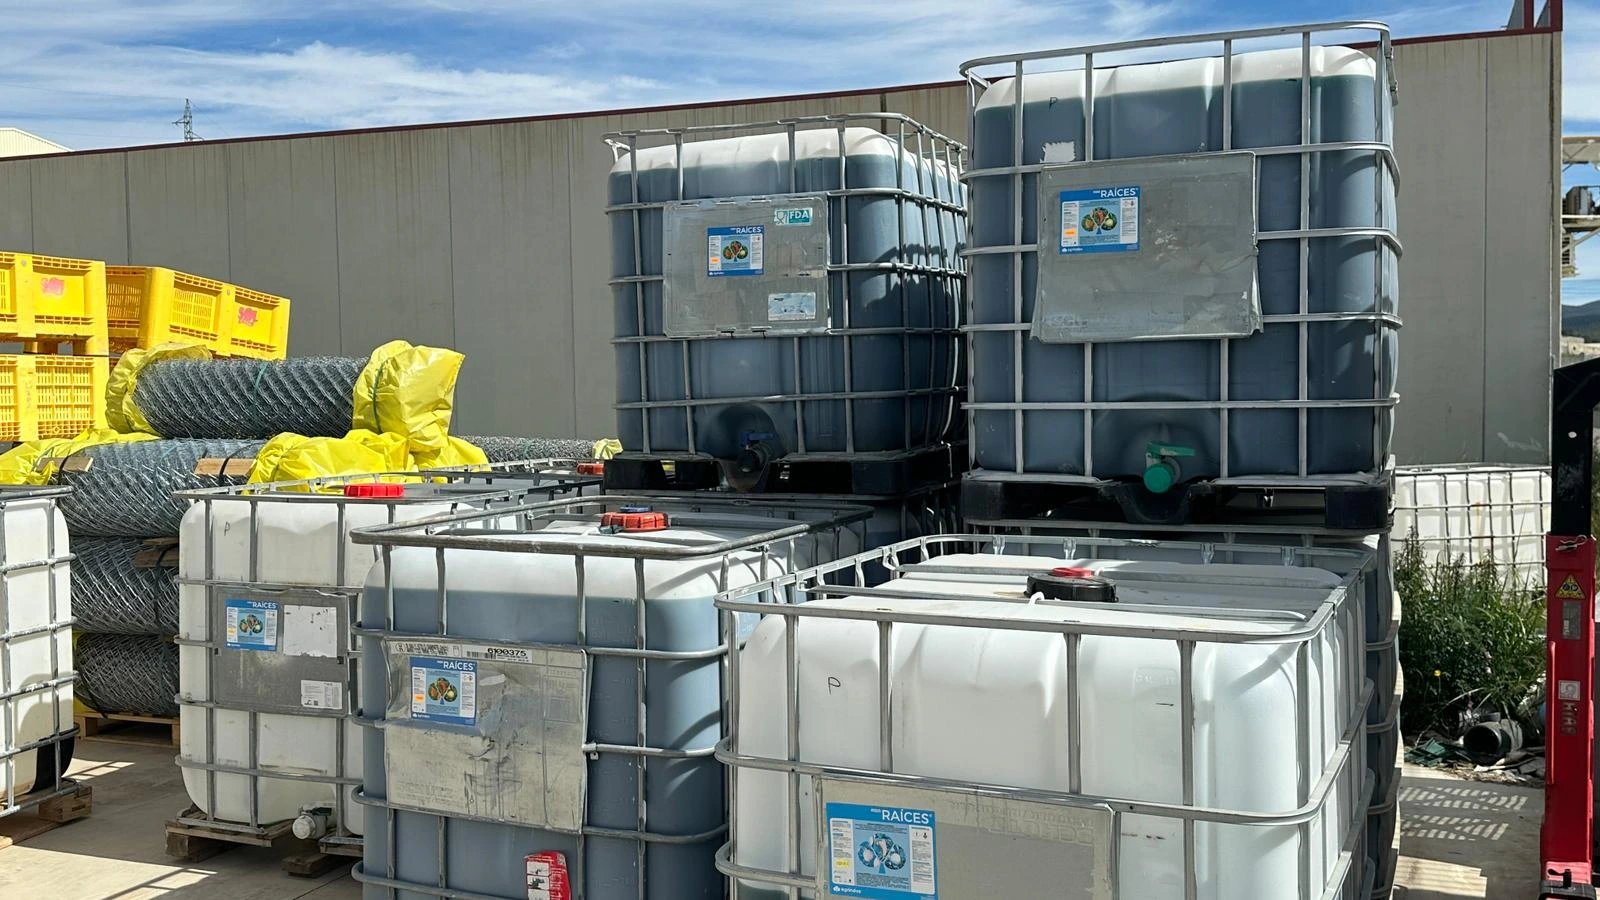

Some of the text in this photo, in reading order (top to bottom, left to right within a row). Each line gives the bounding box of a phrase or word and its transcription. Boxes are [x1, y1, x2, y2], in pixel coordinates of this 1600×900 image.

[1100, 187, 1136, 198] RAÍCES
[789, 210, 809, 219] FDA
[736, 226, 762, 234] RAÍCES
[252, 601, 277, 609] RAÍCES
[443, 660, 474, 671] RAÍCES
[827, 676, 841, 695] P
[881, 809, 930, 824] RAÍCES
